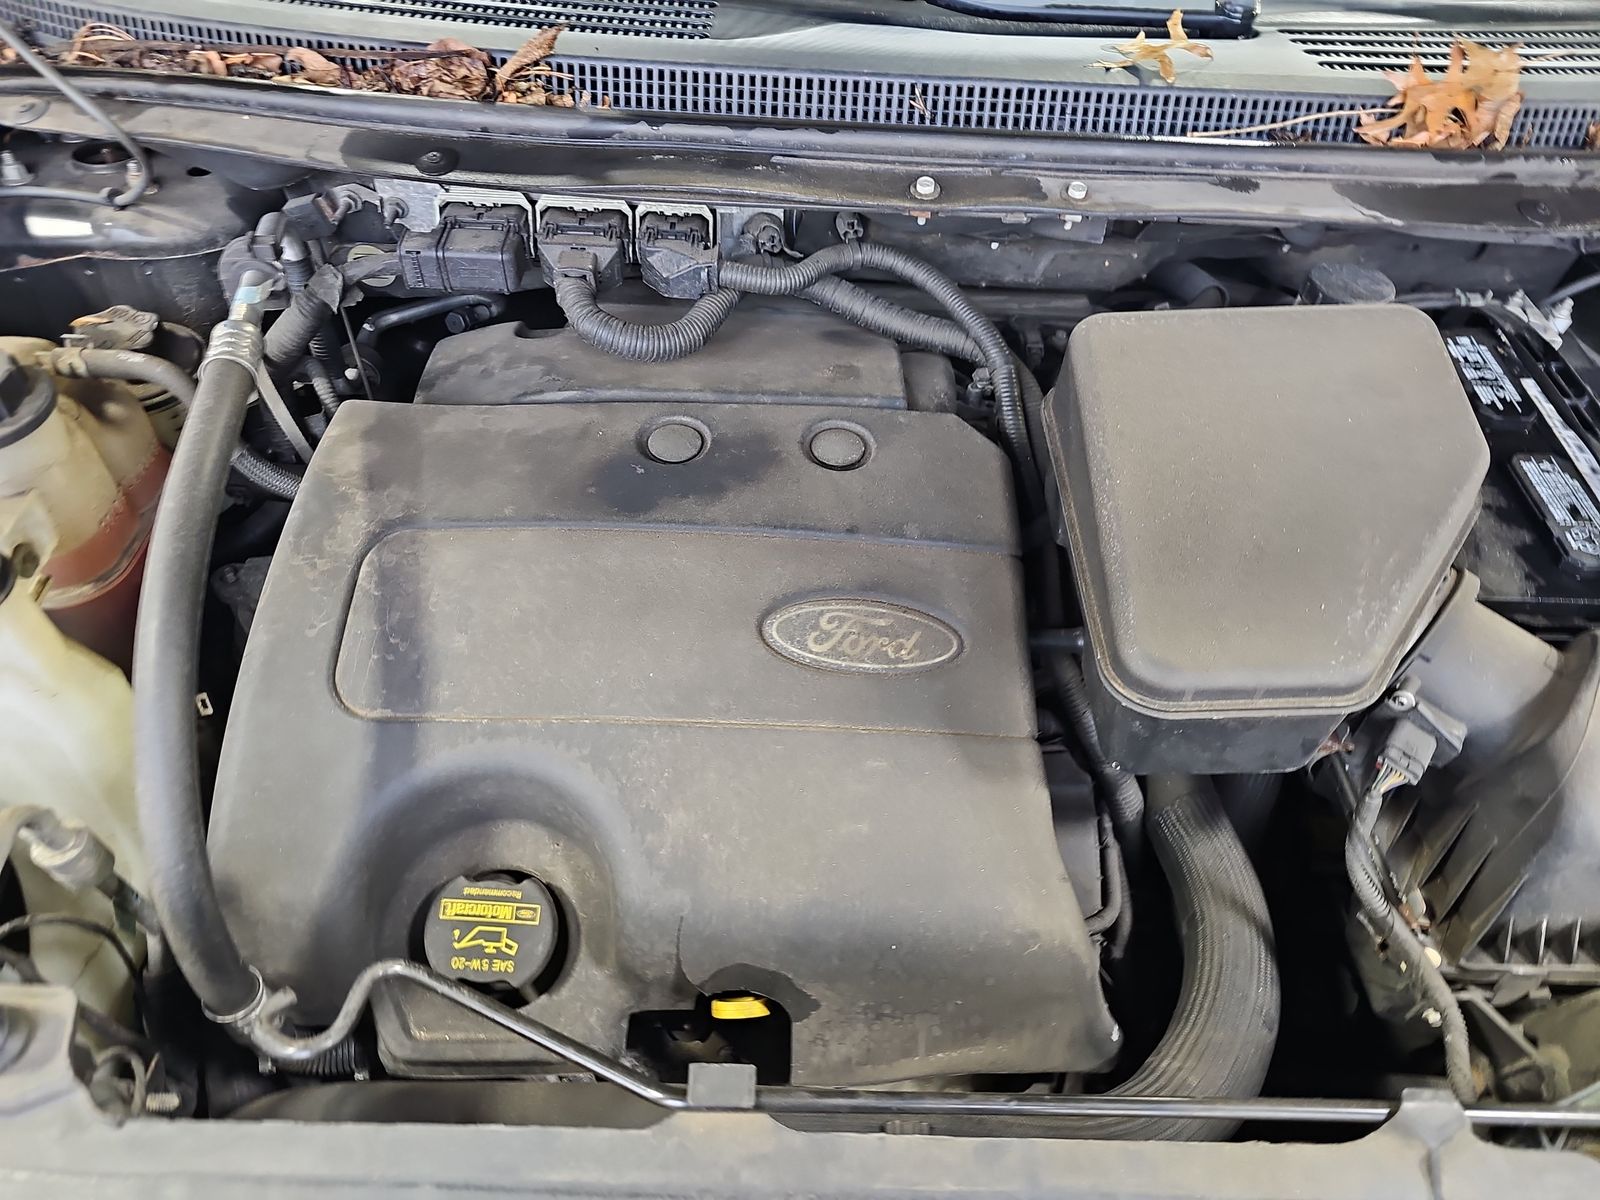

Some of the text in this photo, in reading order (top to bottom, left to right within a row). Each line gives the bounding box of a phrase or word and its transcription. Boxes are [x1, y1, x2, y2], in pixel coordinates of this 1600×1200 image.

[807, 611, 922, 660] Ford
[463, 887, 522, 899] Recommended
[444, 901, 513, 920] Motorcraft
[492, 959, 515, 973] SAE
